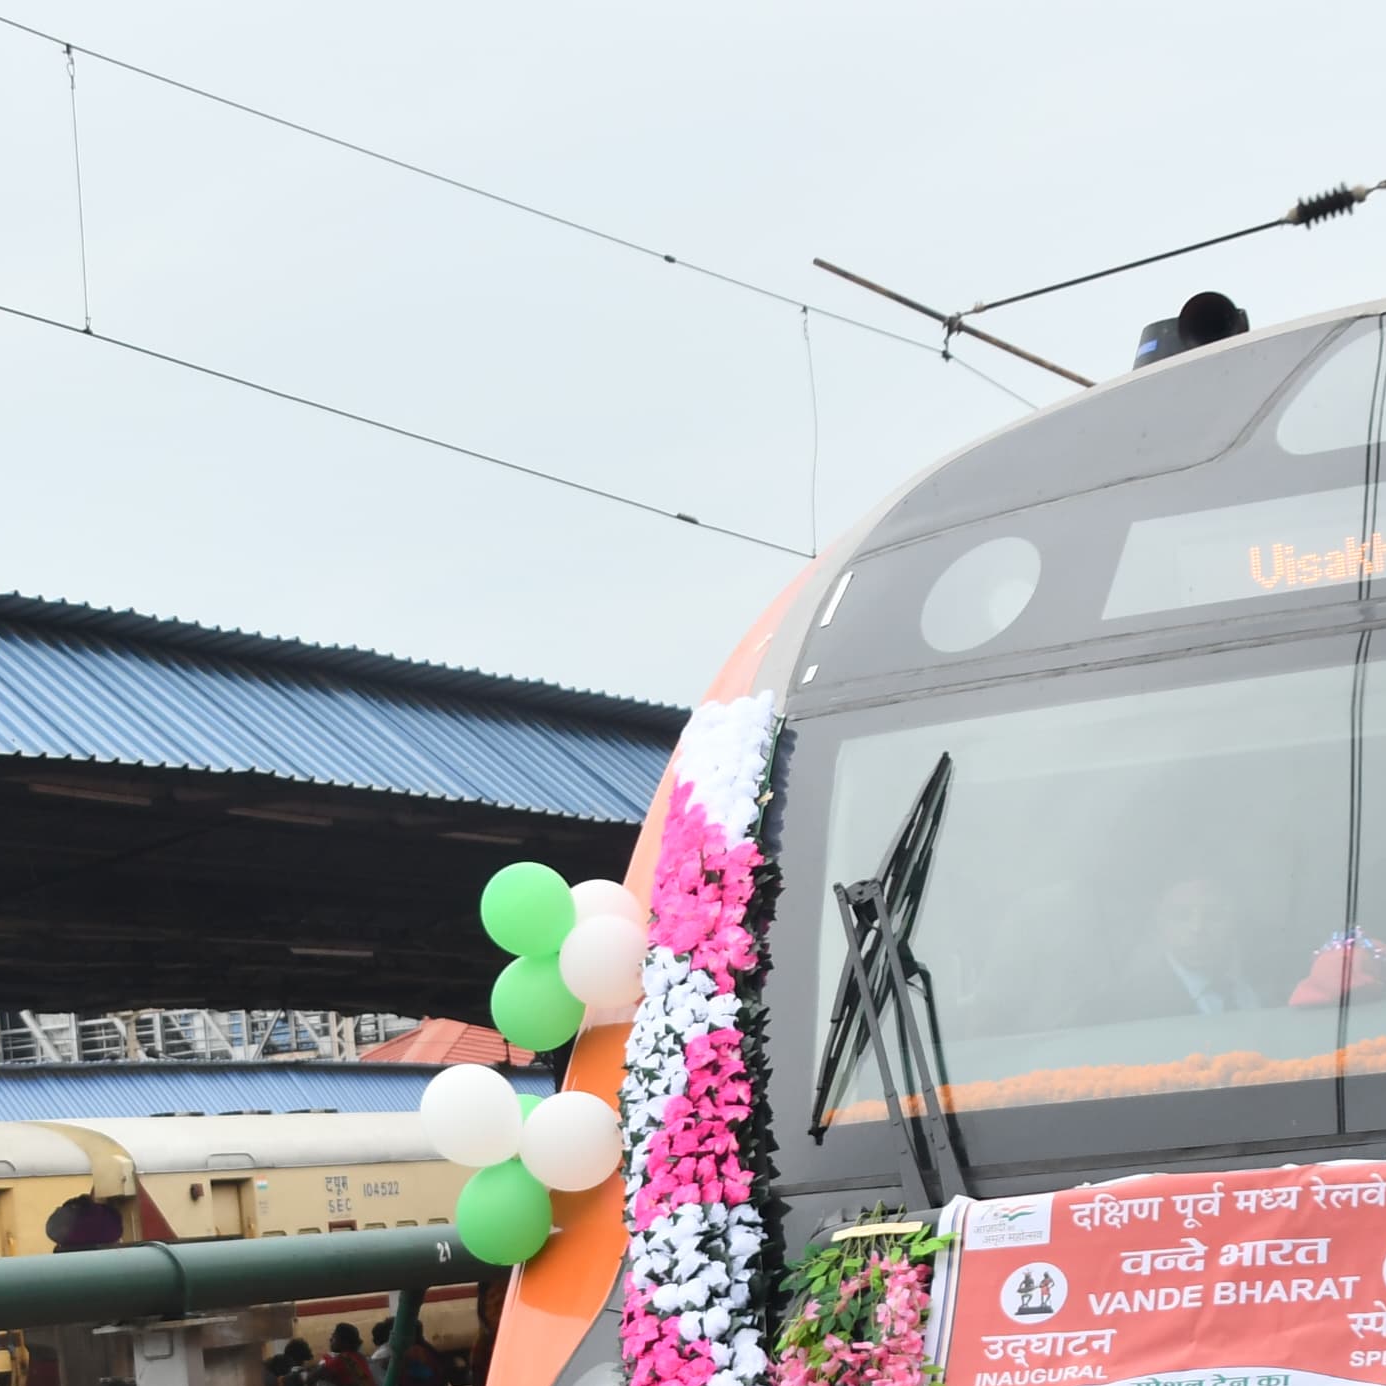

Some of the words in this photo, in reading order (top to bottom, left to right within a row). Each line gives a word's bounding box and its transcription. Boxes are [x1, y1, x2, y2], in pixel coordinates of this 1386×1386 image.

[363, 1181, 400, 1197] 104522
[328, 1199, 353, 1213] SEC
[1070, 1193, 1164, 1231] दक्षिण
[1171, 1181, 1225, 1229] पूर्व
[1233, 1185, 1303, 1214] मध्य
[436, 1240, 452, 1263] 21
[1120, 1237, 1208, 1275] वन्दे
[1219, 1237, 1332, 1268] भारत
[1088, 1284, 1205, 1316] VANDE
[1213, 1275, 1361, 1306] BHARAT
